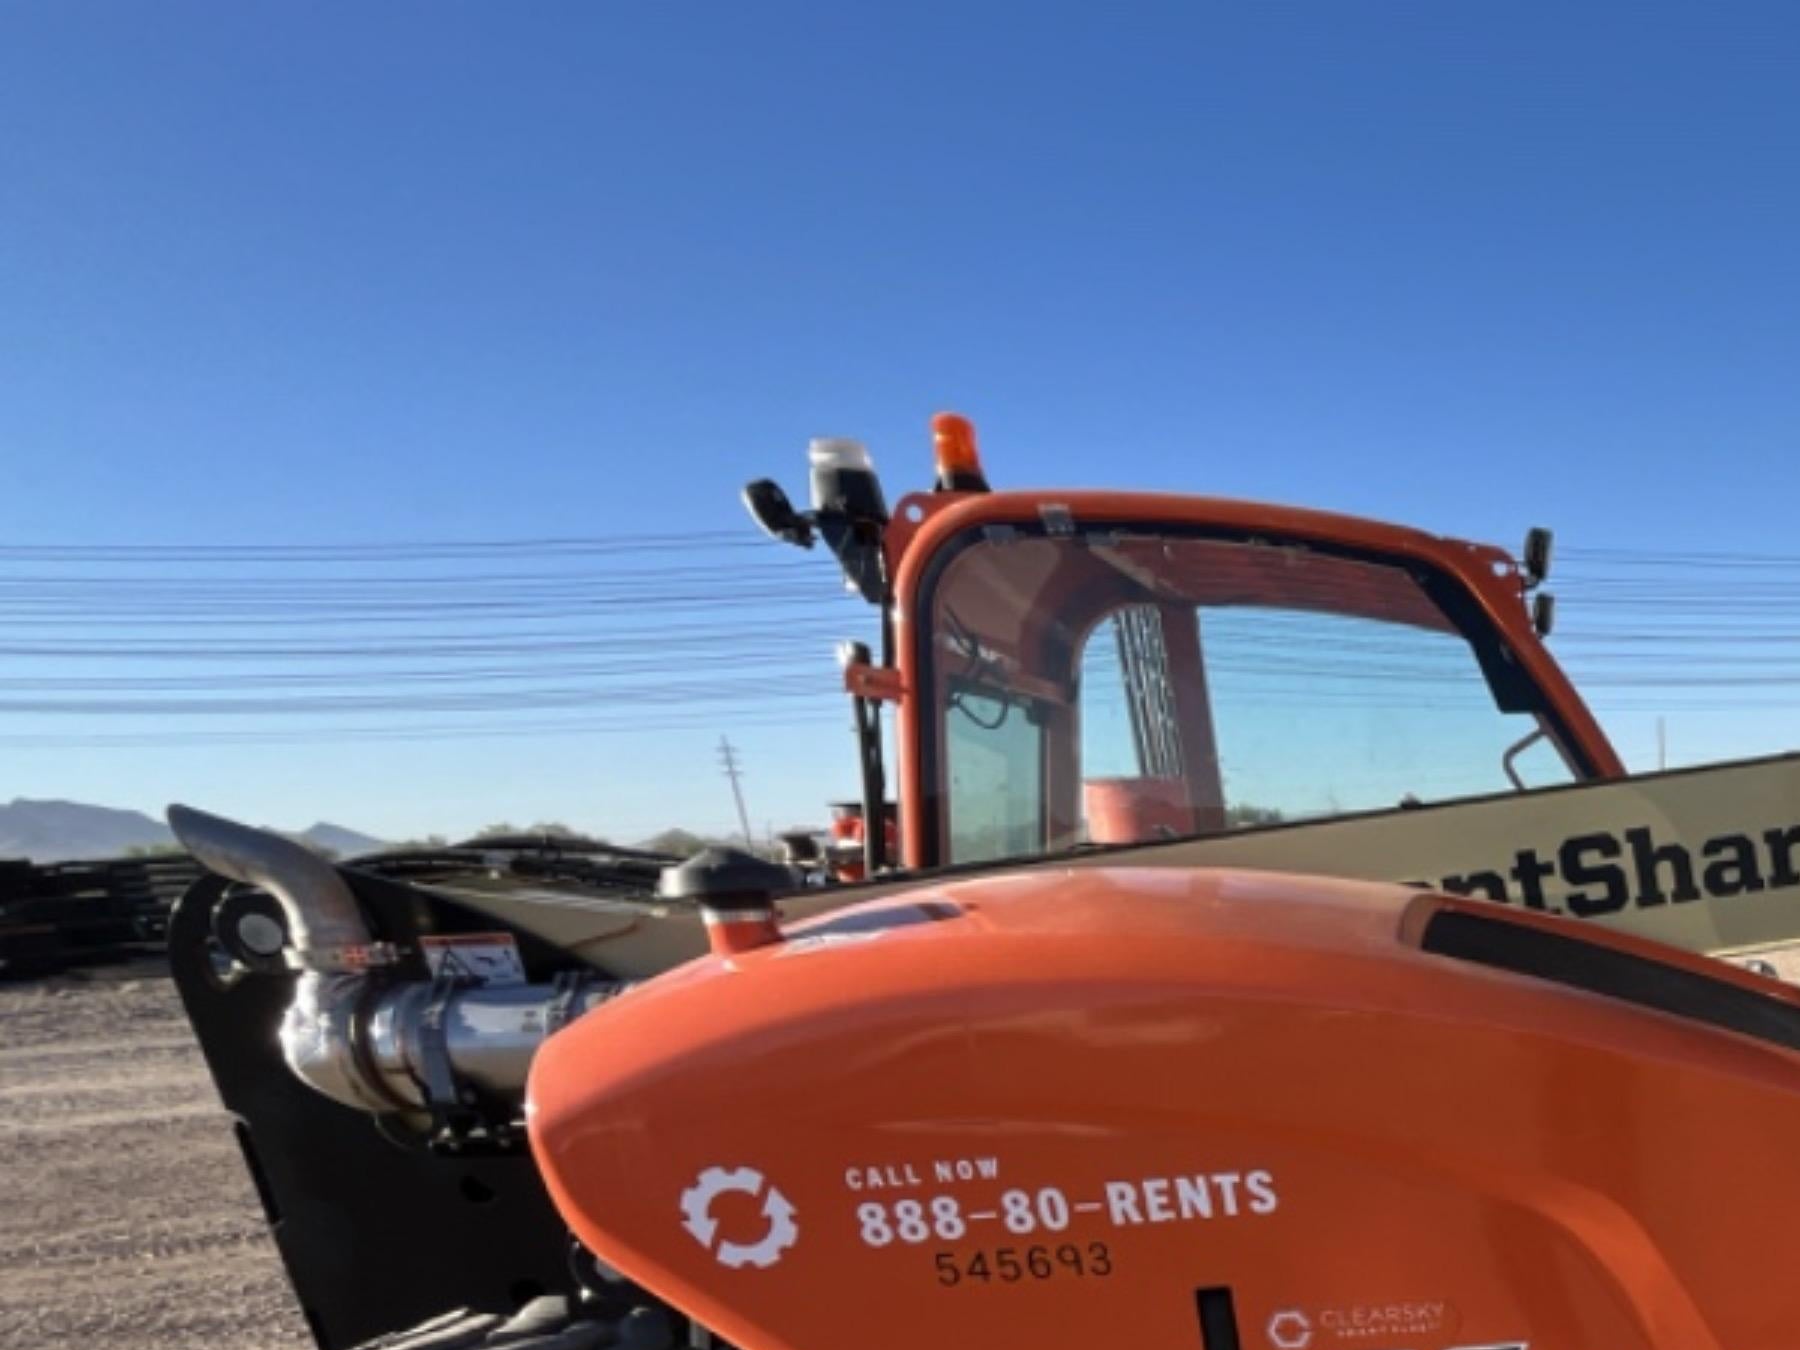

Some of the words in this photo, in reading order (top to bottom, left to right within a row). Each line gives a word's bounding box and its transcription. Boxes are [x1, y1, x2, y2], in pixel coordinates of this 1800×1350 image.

[845, 1163, 921, 1190] CALL
[935, 1157, 998, 1183] NOW
[857, 1170, 1278, 1247] 888-80-RENTS
[935, 1241, 1113, 1287] 545693
[1319, 1301, 1446, 1329] CLEARSKY
